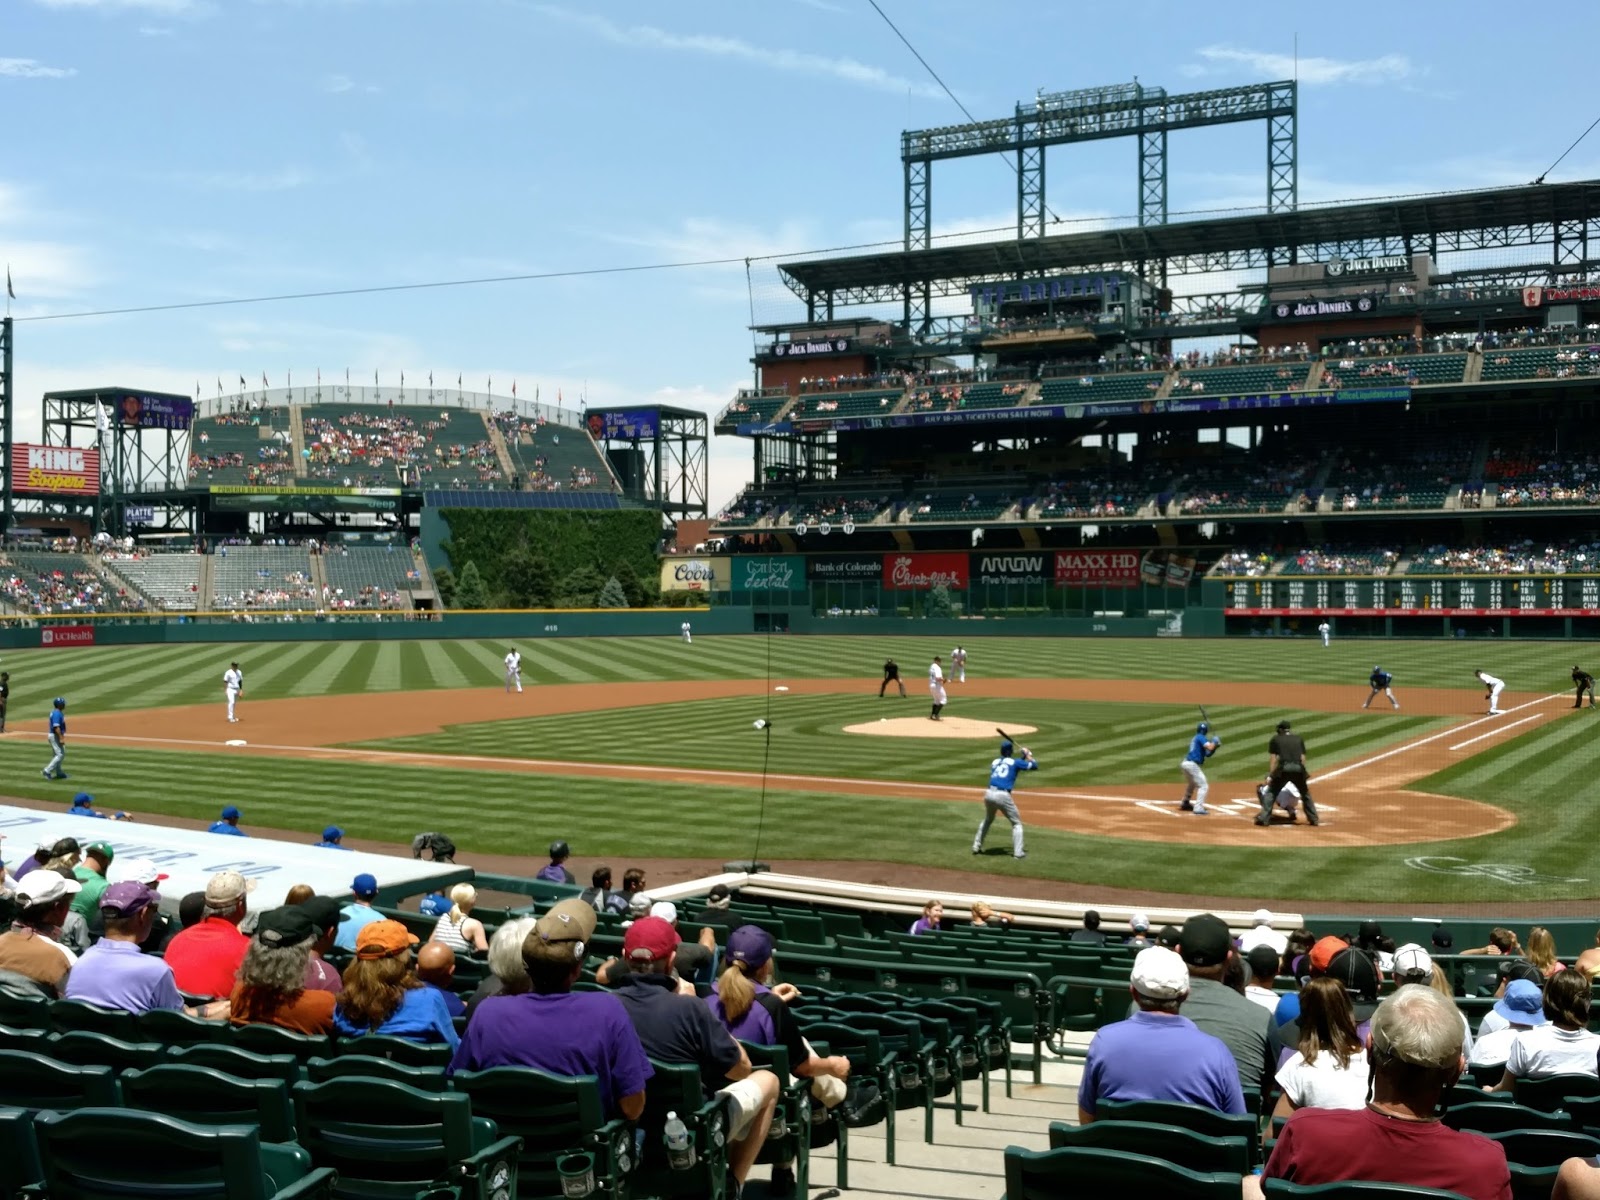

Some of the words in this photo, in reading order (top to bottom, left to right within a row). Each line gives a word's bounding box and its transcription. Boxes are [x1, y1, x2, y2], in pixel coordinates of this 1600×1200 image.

[1346, 258, 1370, 271] JACK
[1372, 255, 1408, 269] DANIEL'S
[1294, 303, 1317, 316] JACK
[1318, 300, 1353, 314] DANIEL'S
[788, 344, 806, 355] JACK
[807, 341, 834, 353] DANIEL'S
[965, 412, 996, 421] TICKETS
[997, 411, 1009, 419] ON
[1011, 410, 1029, 418] SALE
[28, 447, 85, 472] KING
[27, 467, 86, 492] Soopers
[126, 508, 152, 517] PLATTE
[368, 500, 396, 510] Jeep
[746, 557, 789, 573] Comfort
[815, 562, 835, 572] Bank
[836, 562, 845, 571] of
[845, 561, 882, 572] Colorado
[981, 557, 1043, 572] ARROW
[1057, 554, 1109, 569] MAXX
[1111, 554, 1137, 569] HD
[674, 563, 716, 581] Coors
[744, 570, 793, 589] dental
[982, 574, 998, 584] Five
[1000, 575, 1024, 585] Years
[1025, 574, 1043, 585] Out
[1057, 570, 1137, 578] sunglasses
[54, 631, 94, 641] UCHealth
